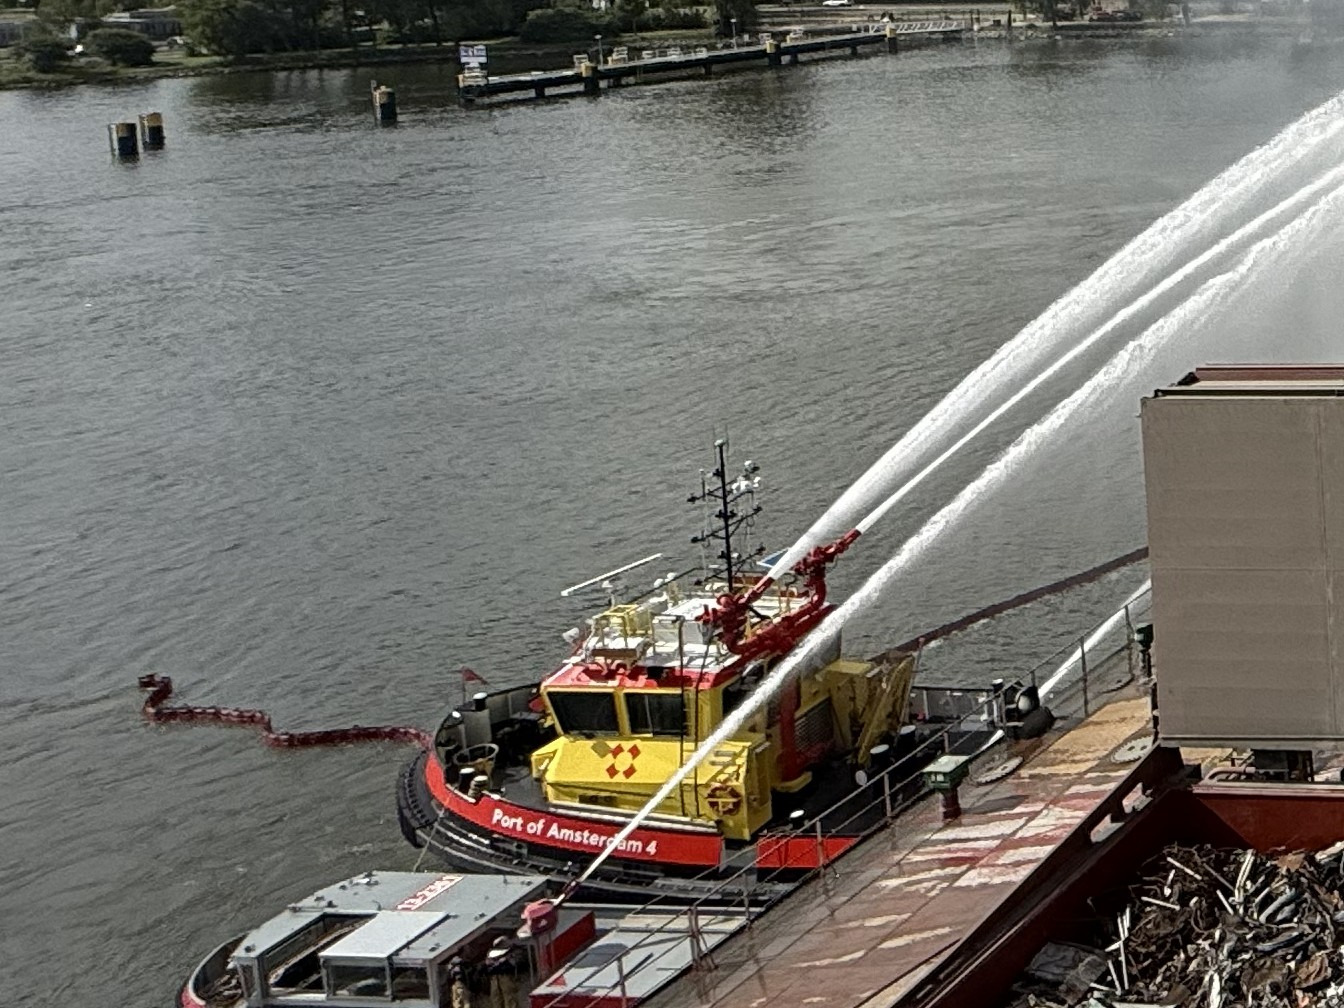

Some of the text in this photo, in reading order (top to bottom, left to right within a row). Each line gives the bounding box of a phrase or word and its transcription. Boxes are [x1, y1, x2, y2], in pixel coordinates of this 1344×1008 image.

[491, 808, 523, 832] Port
[526, 818, 546, 835] of
[645, 840, 657, 856] 4
